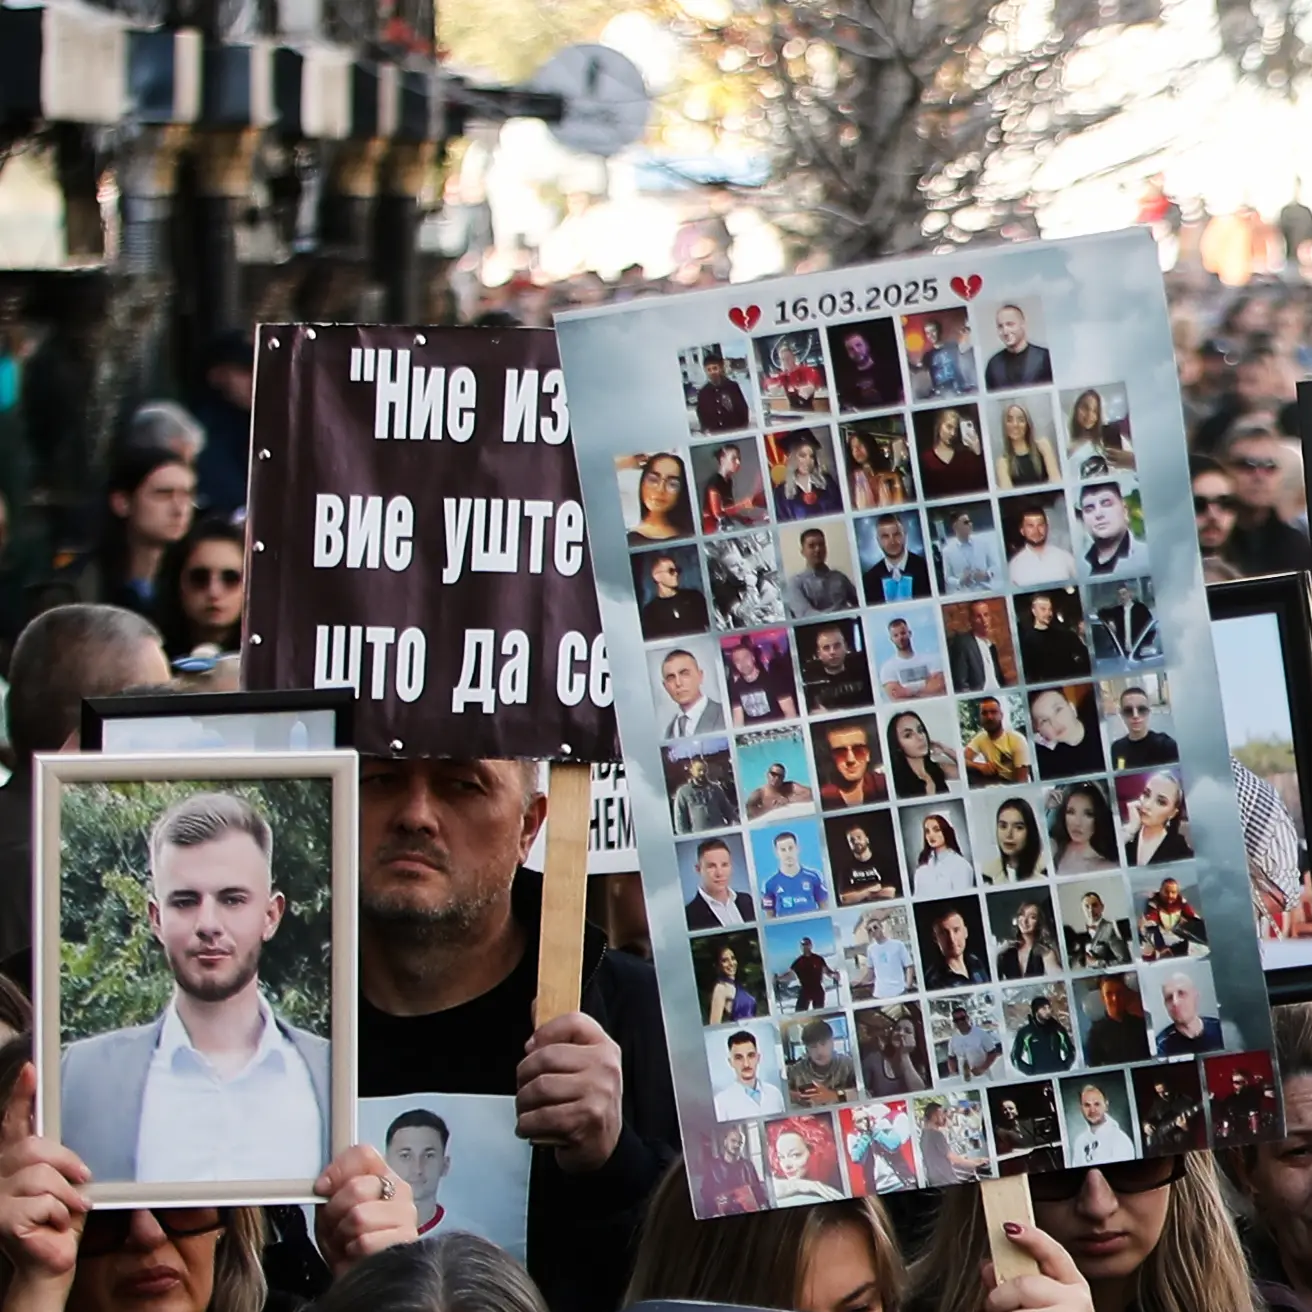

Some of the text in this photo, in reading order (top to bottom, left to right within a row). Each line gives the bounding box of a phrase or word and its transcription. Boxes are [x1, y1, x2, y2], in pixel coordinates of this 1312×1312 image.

[774, 277, 939, 325] 16.03.2025
[313, 494, 585, 585] вие уште
[313, 624, 427, 702] што
[451, 627, 531, 715] да
